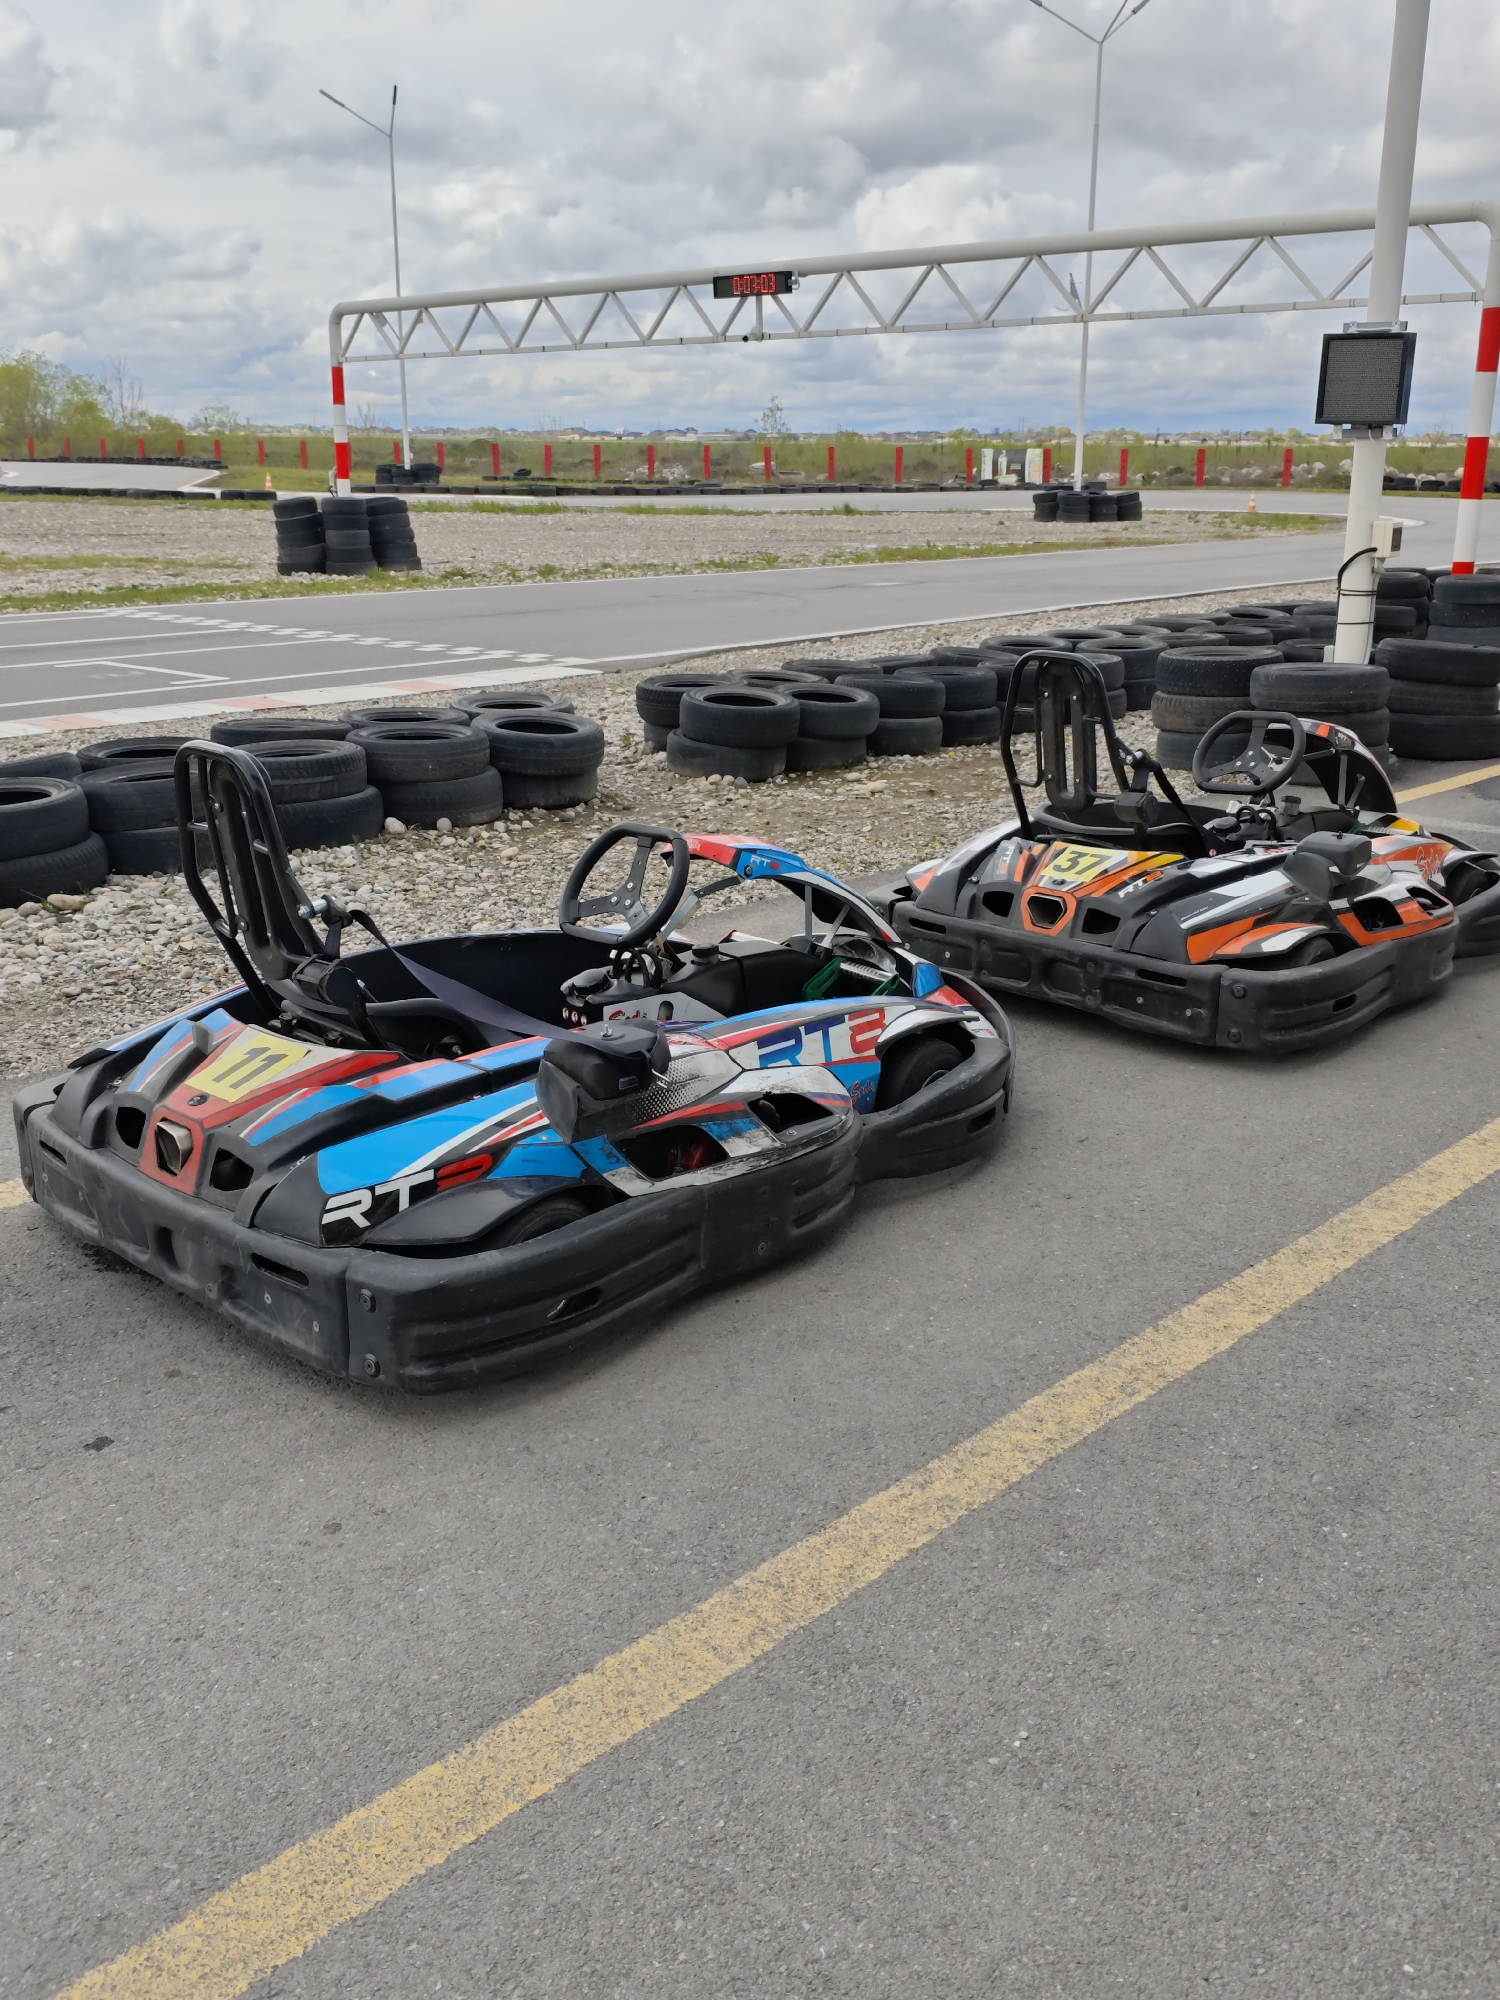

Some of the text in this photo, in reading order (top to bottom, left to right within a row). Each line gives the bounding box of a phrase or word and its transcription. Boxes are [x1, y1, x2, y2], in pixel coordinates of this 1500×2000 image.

[750, 855, 780, 871] RT8
[1052, 850, 1113, 876] 37
[756, 1008, 886, 1068] RT8
[211, 1046, 289, 1089] 11
